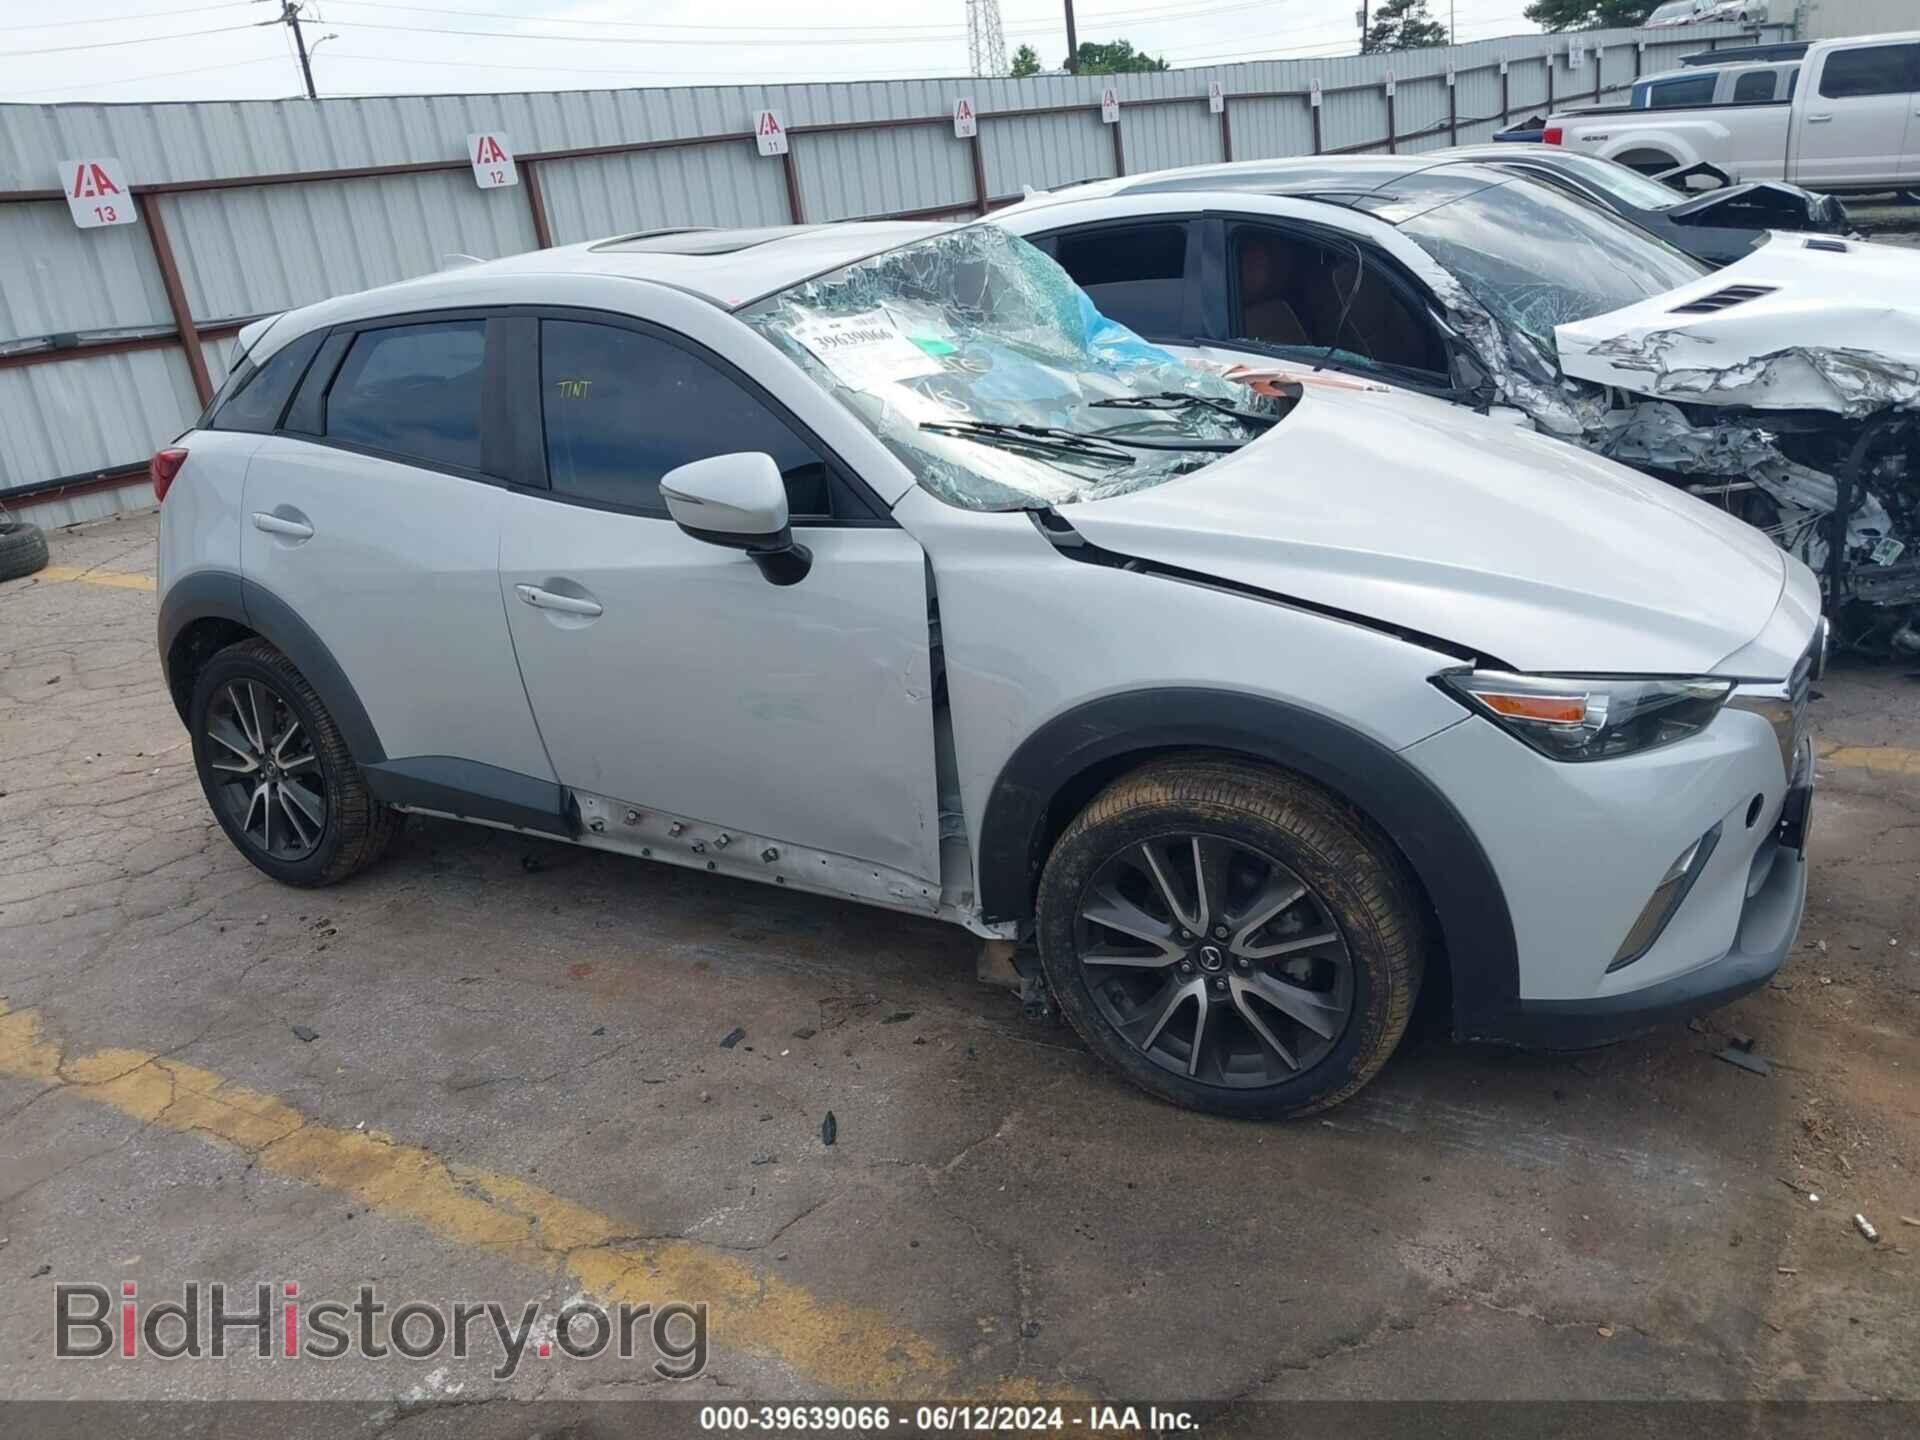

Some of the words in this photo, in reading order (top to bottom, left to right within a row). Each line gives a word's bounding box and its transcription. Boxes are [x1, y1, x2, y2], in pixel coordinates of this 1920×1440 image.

[768, 141, 778, 152] 11
[490, 171, 505, 184] 12
[94, 206, 117, 222] 13
[813, 329, 894, 350] 39639066
[556, 380, 592, 399] TINT
